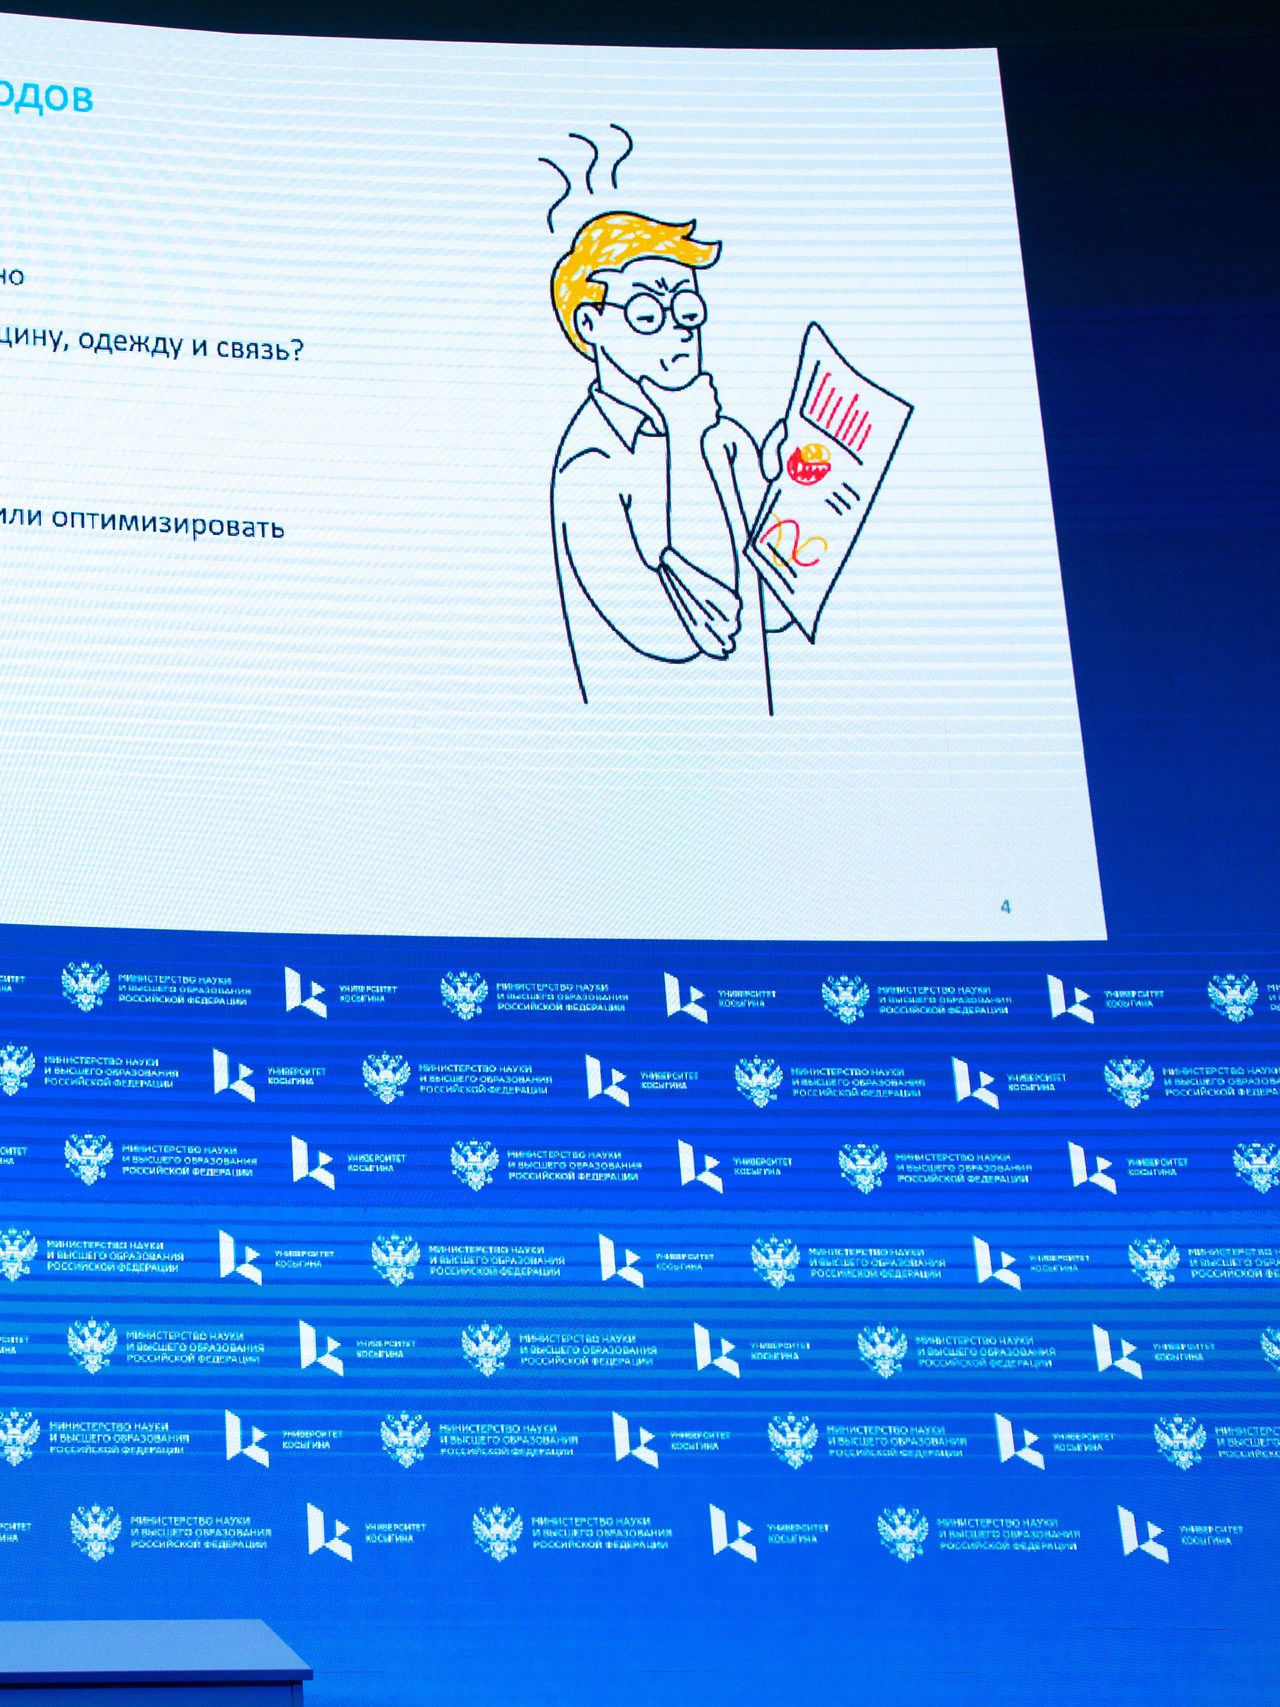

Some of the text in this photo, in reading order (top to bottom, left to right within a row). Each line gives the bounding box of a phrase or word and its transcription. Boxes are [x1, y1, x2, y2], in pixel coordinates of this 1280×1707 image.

[78, 331, 184, 360] одежду
[192, 338, 208, 357] и
[216, 337, 305, 361] связь?
[51, 510, 285, 541] оптимизировать
[1001, 899, 1011, 913] 4
